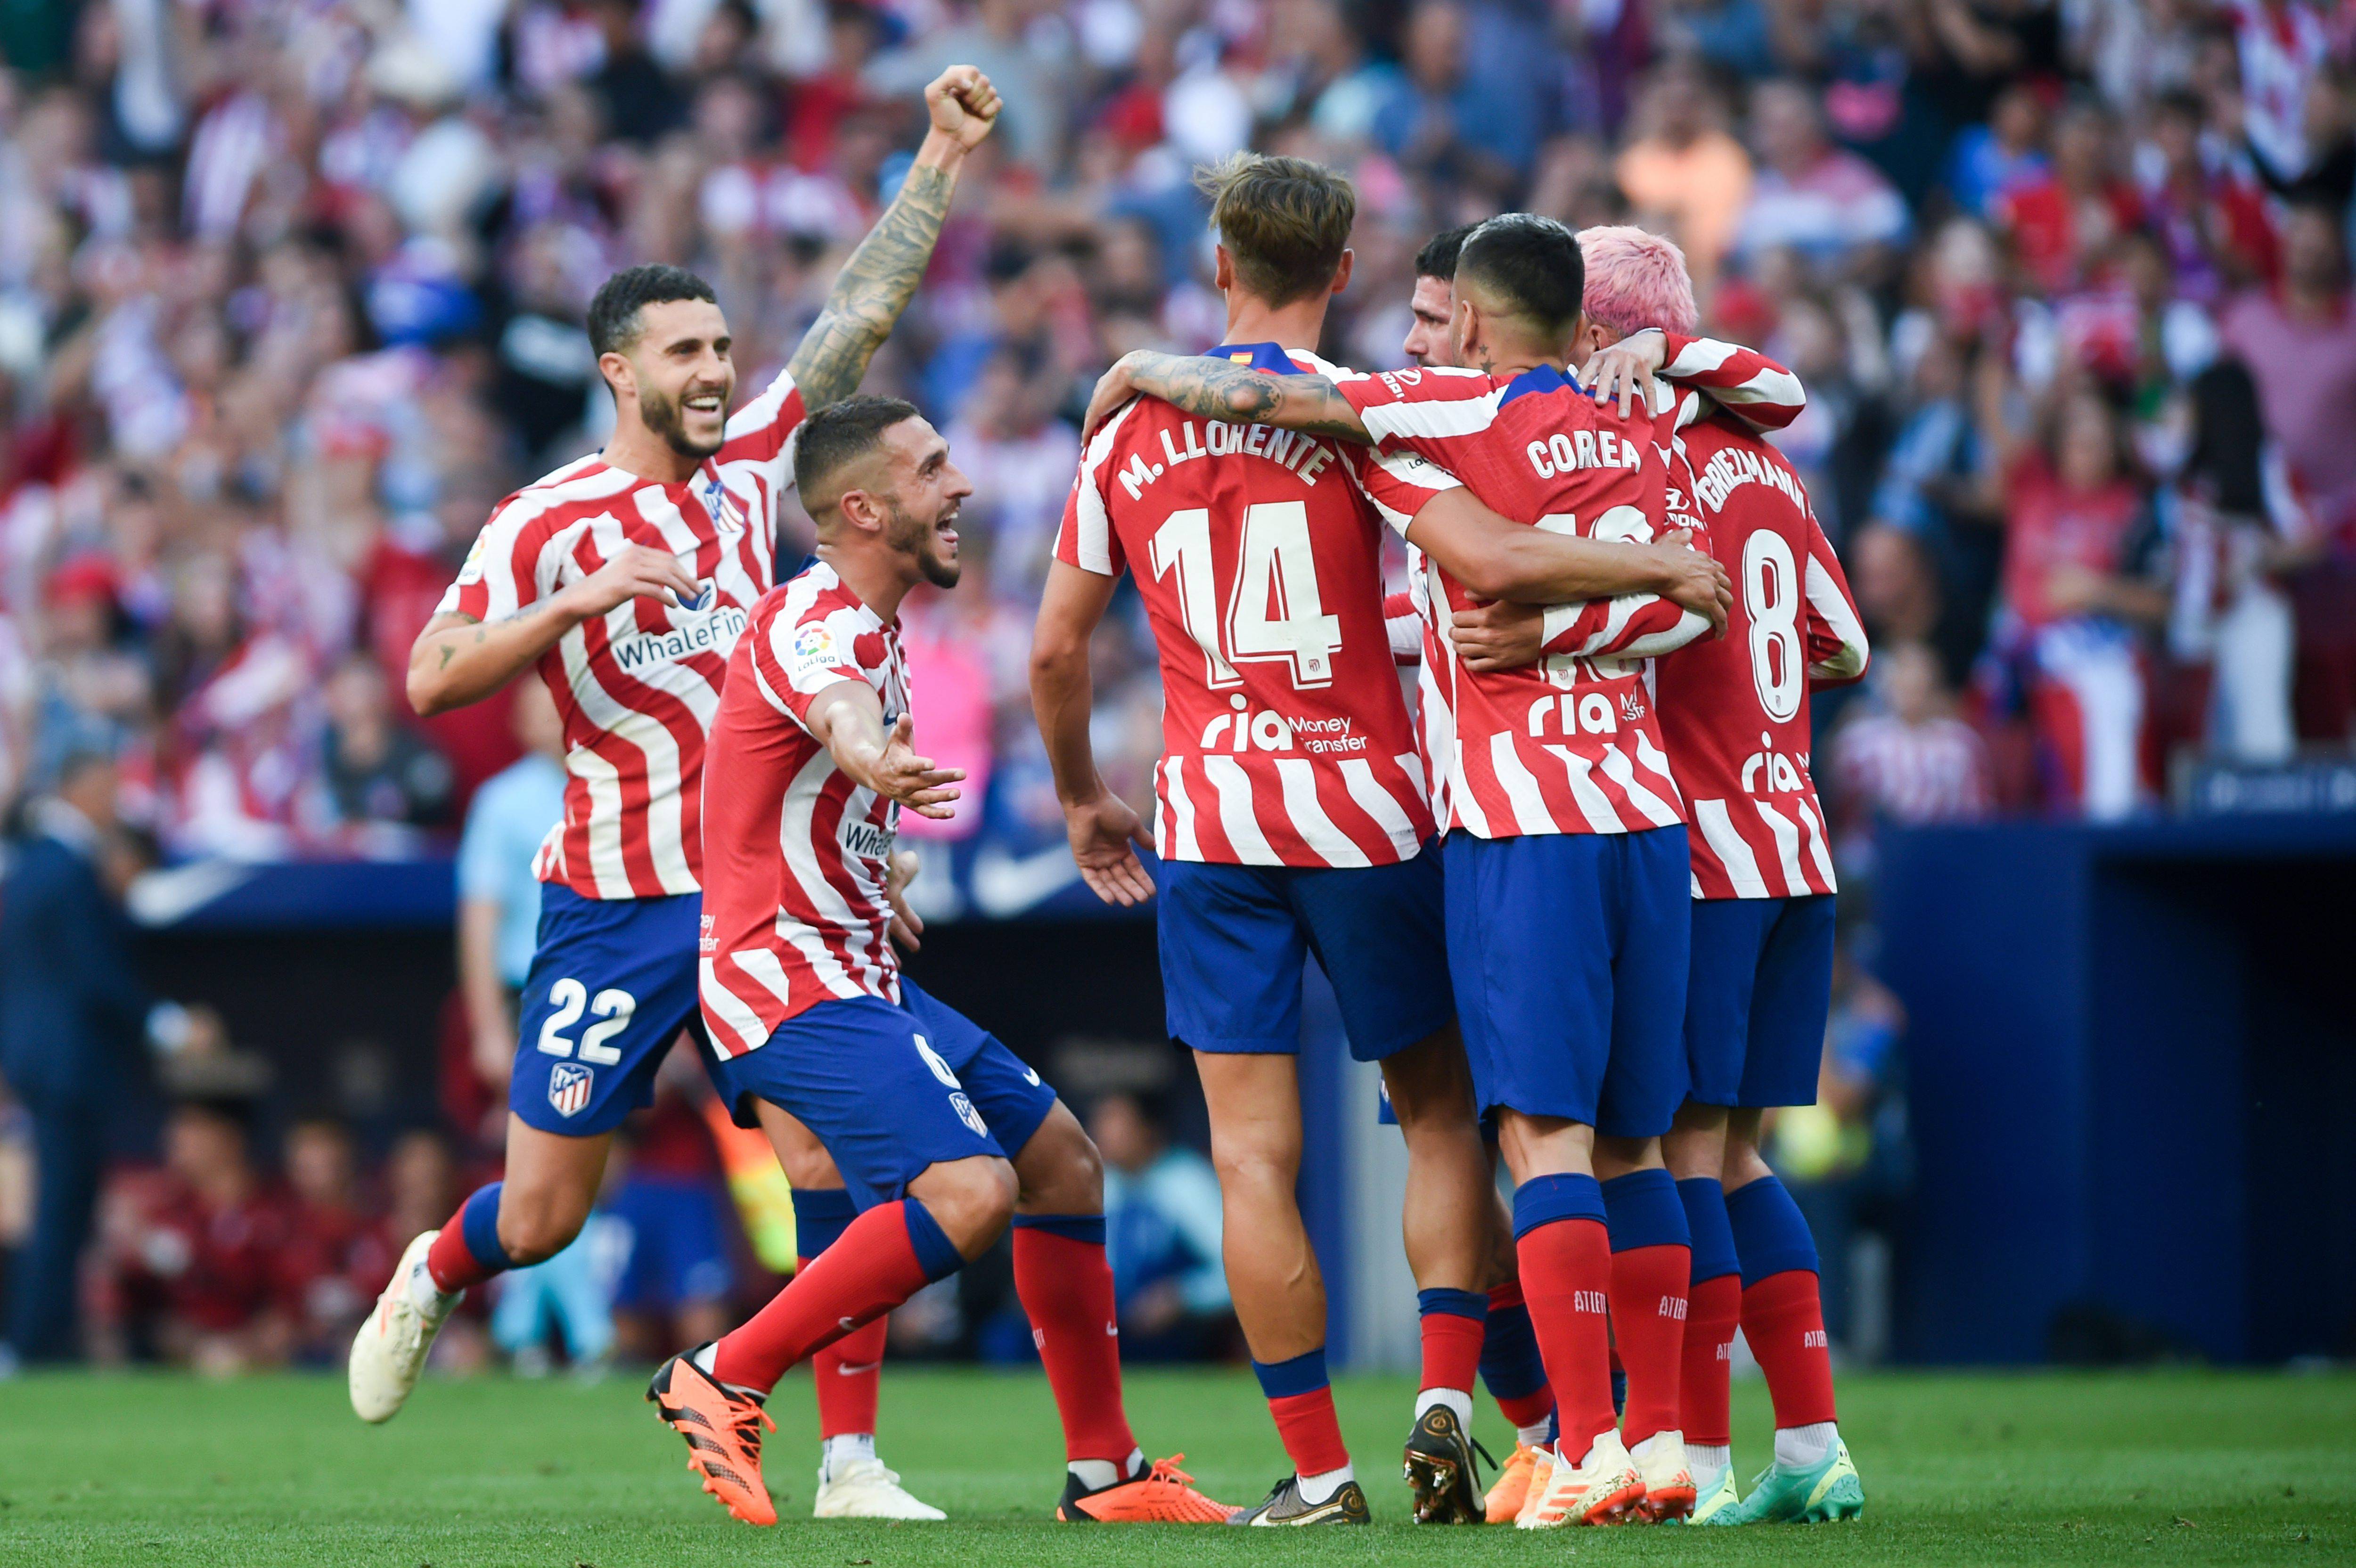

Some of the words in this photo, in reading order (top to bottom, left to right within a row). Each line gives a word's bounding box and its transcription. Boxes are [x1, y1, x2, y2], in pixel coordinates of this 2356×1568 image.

[1118, 452, 1164, 501] M.
[1159, 420, 1335, 487] LLORENTE
[1148, 500, 1342, 690] 14
[616, 612, 746, 669] WhaleFin
[1742, 529, 1803, 724] 8
[798, 655, 835, 672] LaLiga
[1200, 693, 1293, 752] ria
[1288, 716, 1351, 735] Money
[1300, 734, 1367, 753] ransfer
[1528, 693, 1618, 737] ria
[1741, 730, 1805, 793] ria
[537, 978, 636, 1066] 22
[913, 1033, 962, 1090] 6
